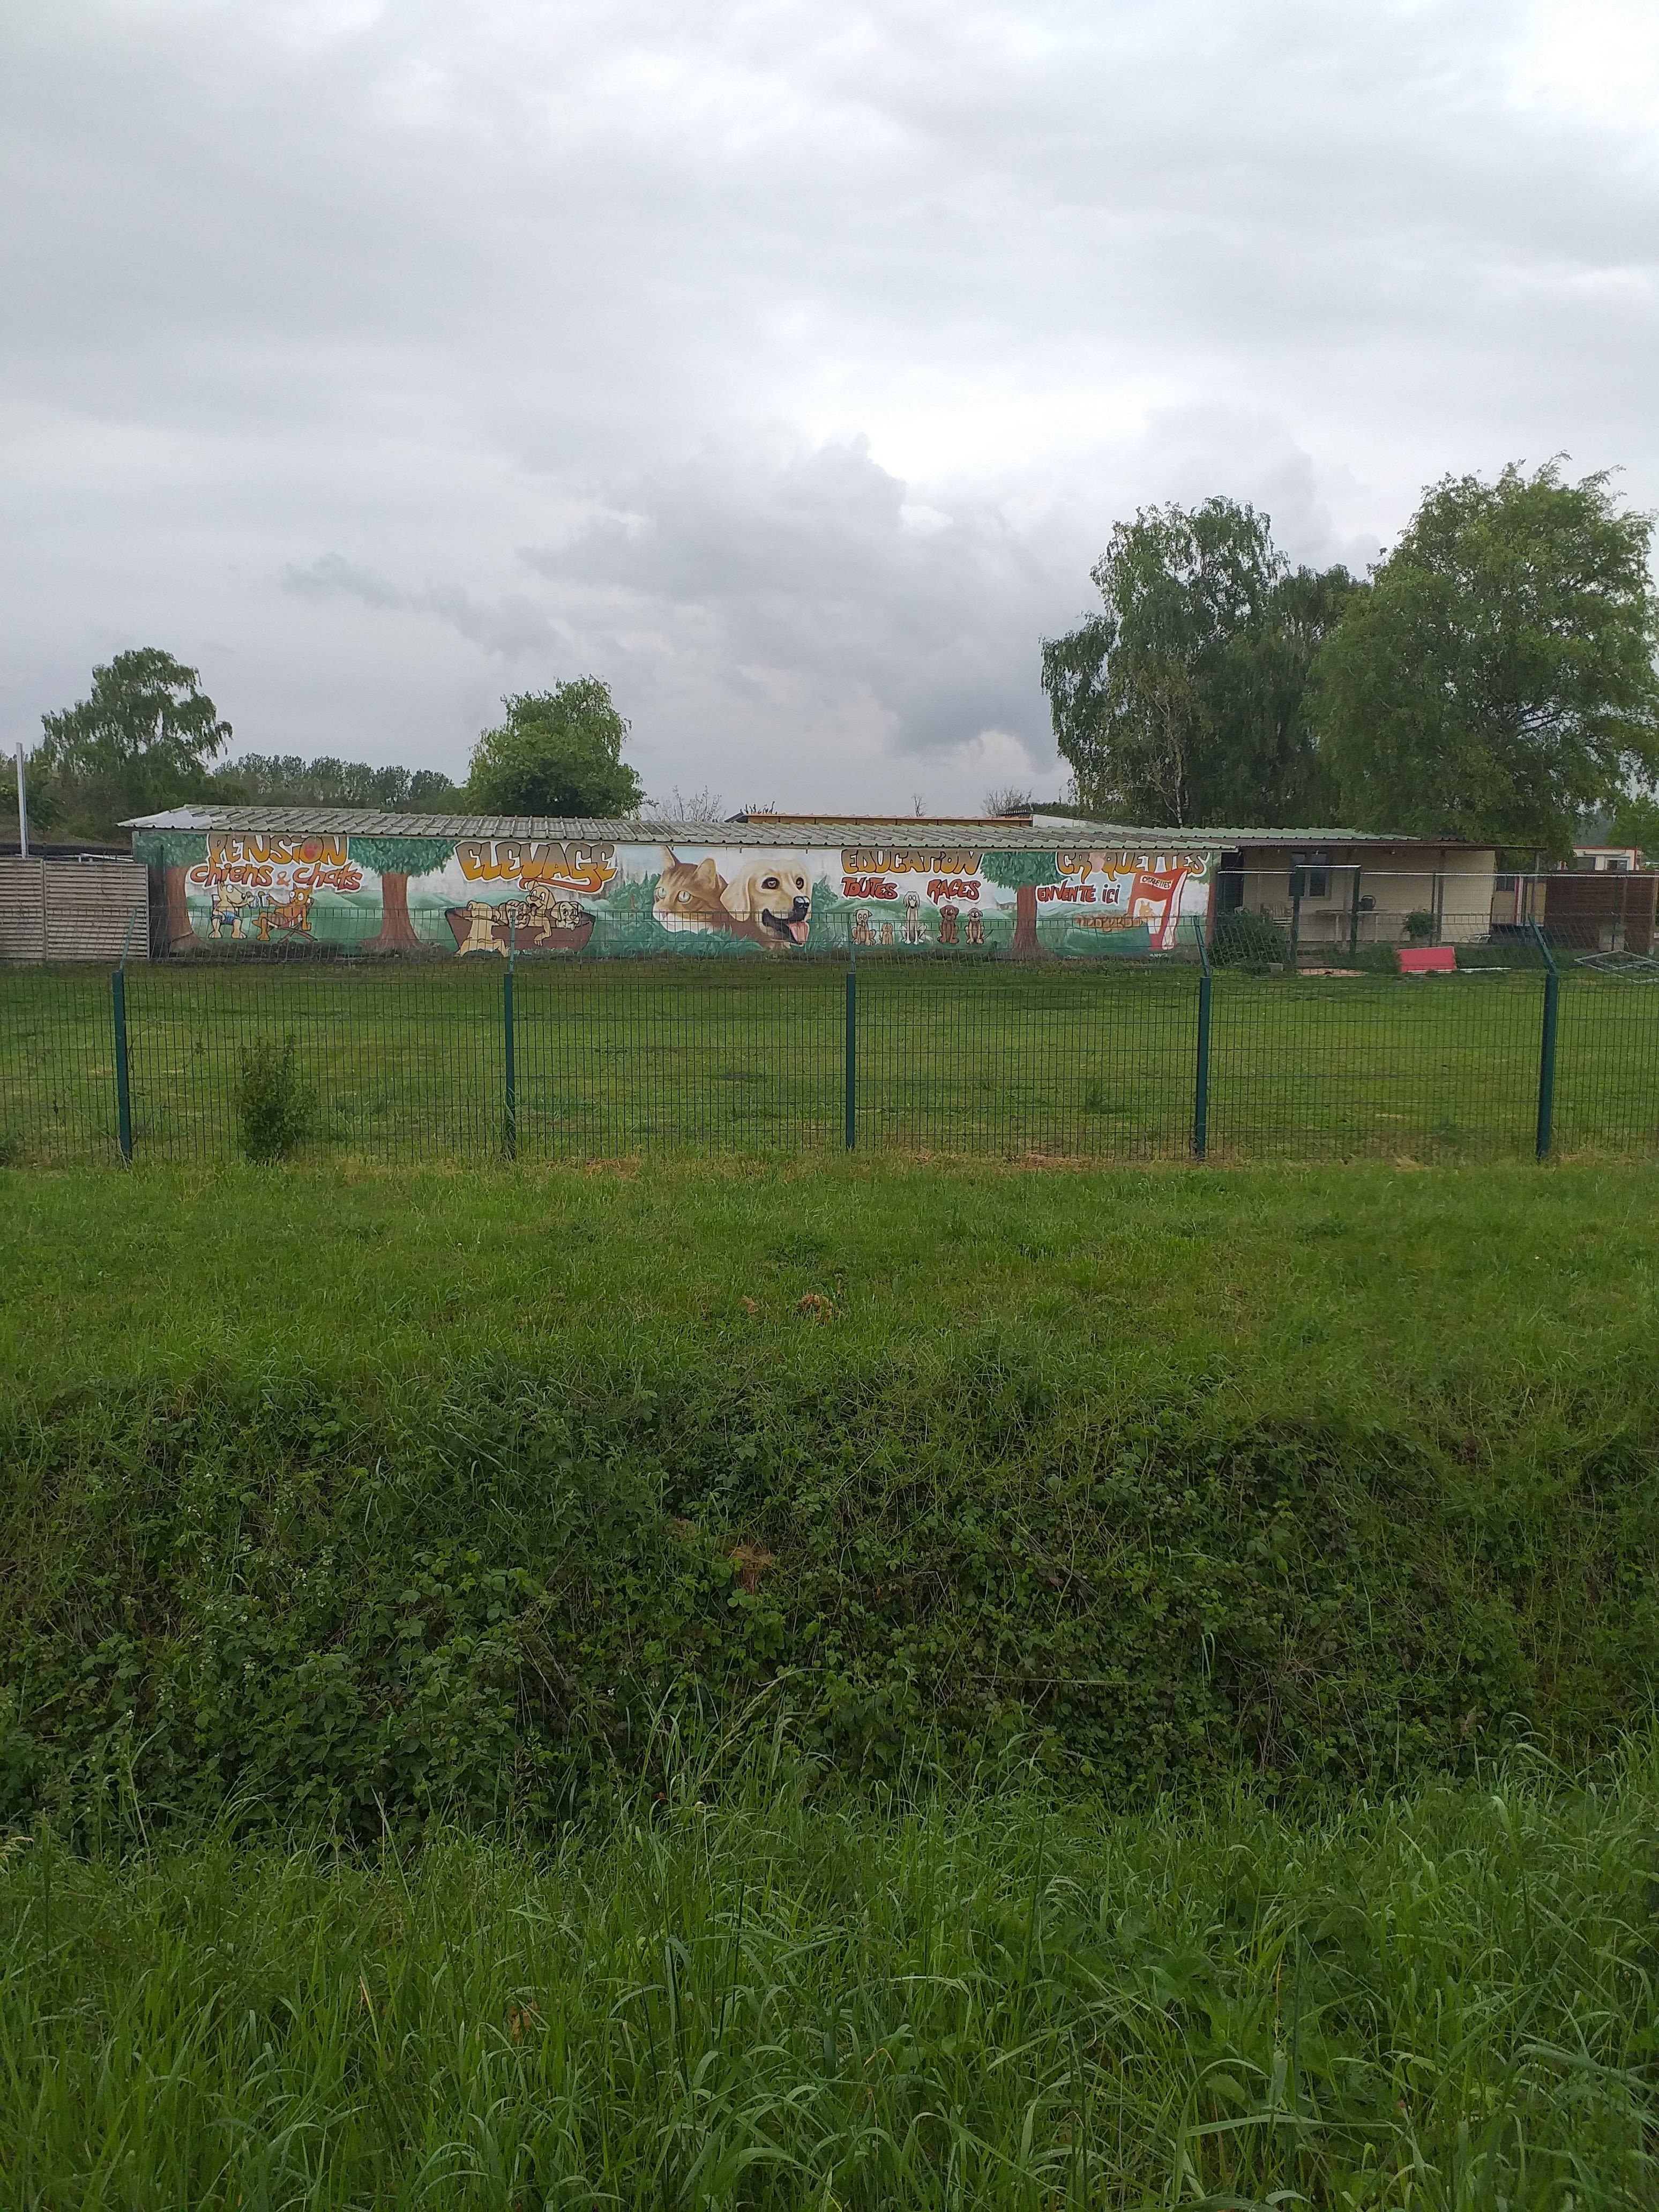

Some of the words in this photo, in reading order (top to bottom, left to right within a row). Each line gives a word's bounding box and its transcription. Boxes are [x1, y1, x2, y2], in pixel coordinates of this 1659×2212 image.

[275, 870, 292, 887] &
[293, 862, 363, 891] chats
[455, 841, 617, 893] ELEVAGE
[841, 877, 898, 900] TOUTES
[927, 878, 981, 904] RACES
